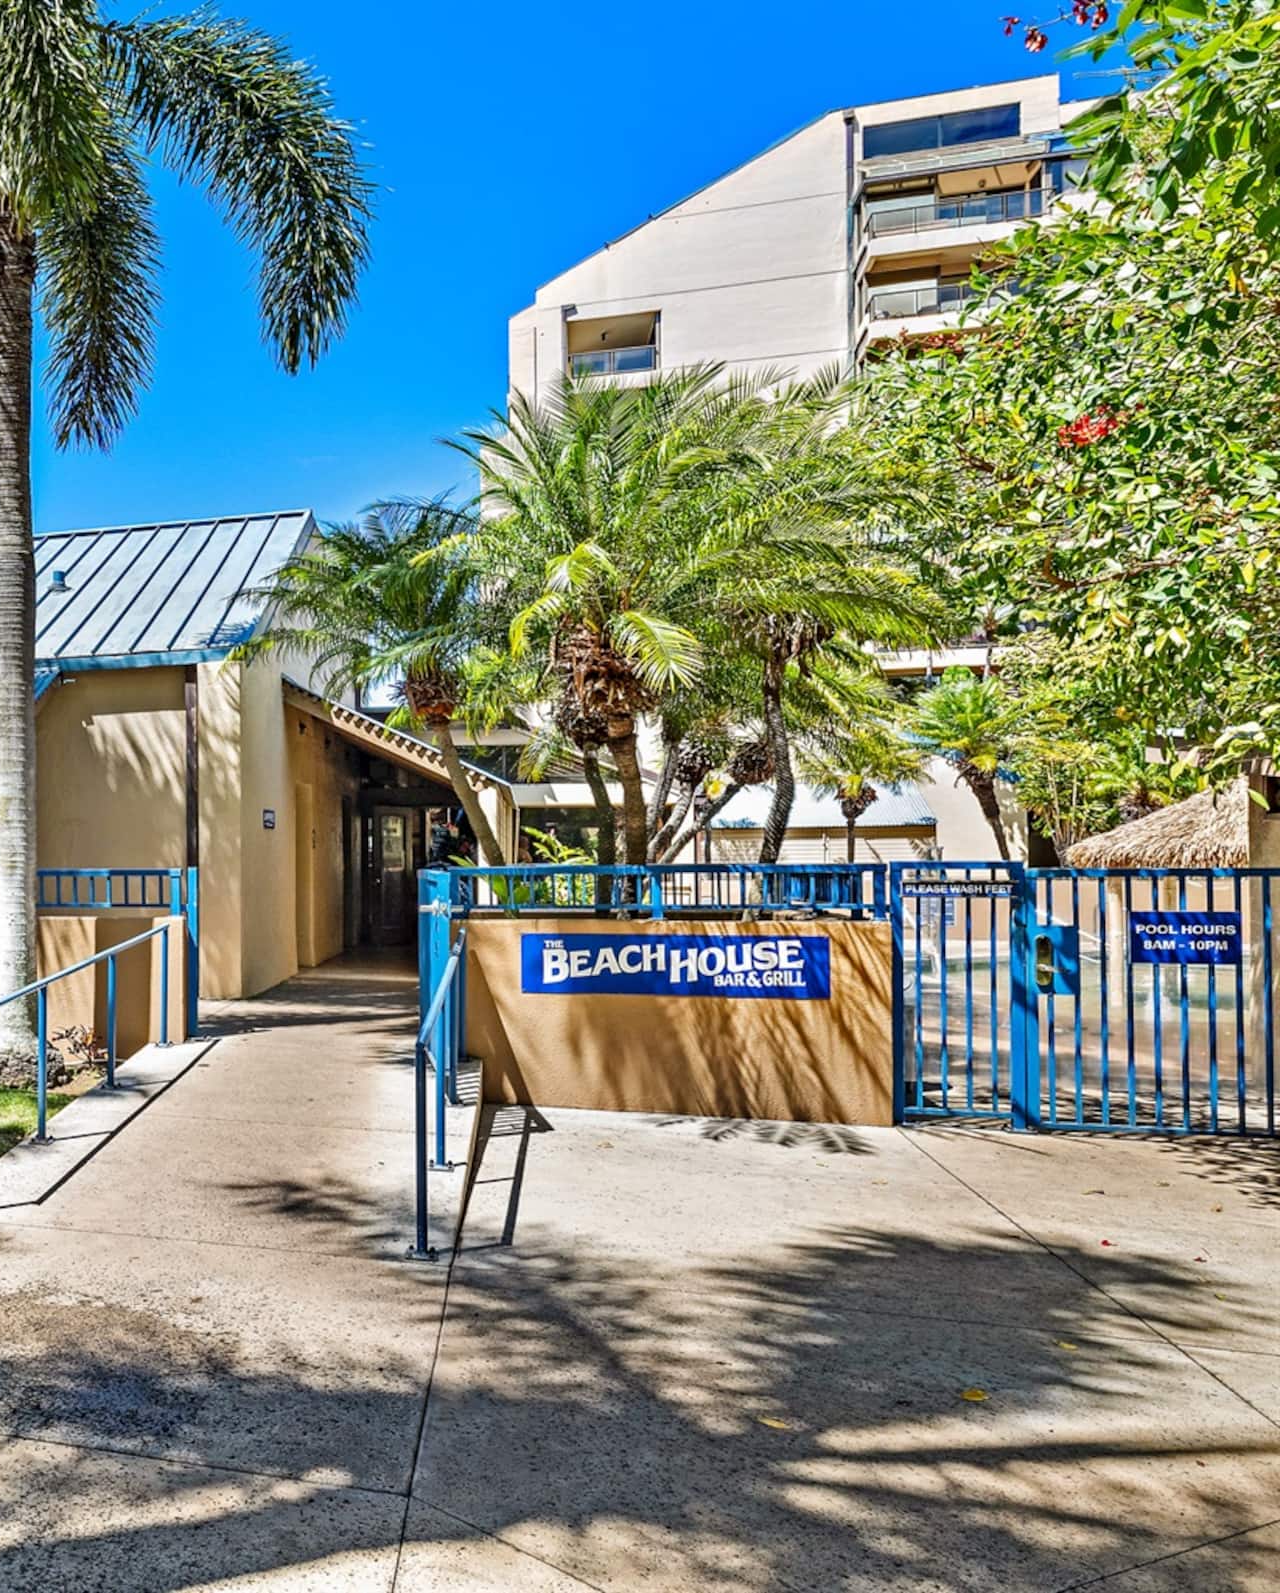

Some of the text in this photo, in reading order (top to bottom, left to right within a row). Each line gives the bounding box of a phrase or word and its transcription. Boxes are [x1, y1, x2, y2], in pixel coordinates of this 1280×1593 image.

[905, 884, 1014, 895] PLEASE WASH FEET
[1135, 924, 1237, 936] POOL HOURS
[543, 940, 565, 949] THE
[1143, 940, 1176, 951] 8AM
[1187, 940, 1229, 951] 10PM
[542, 940, 805, 984] BEACH HOUSE
